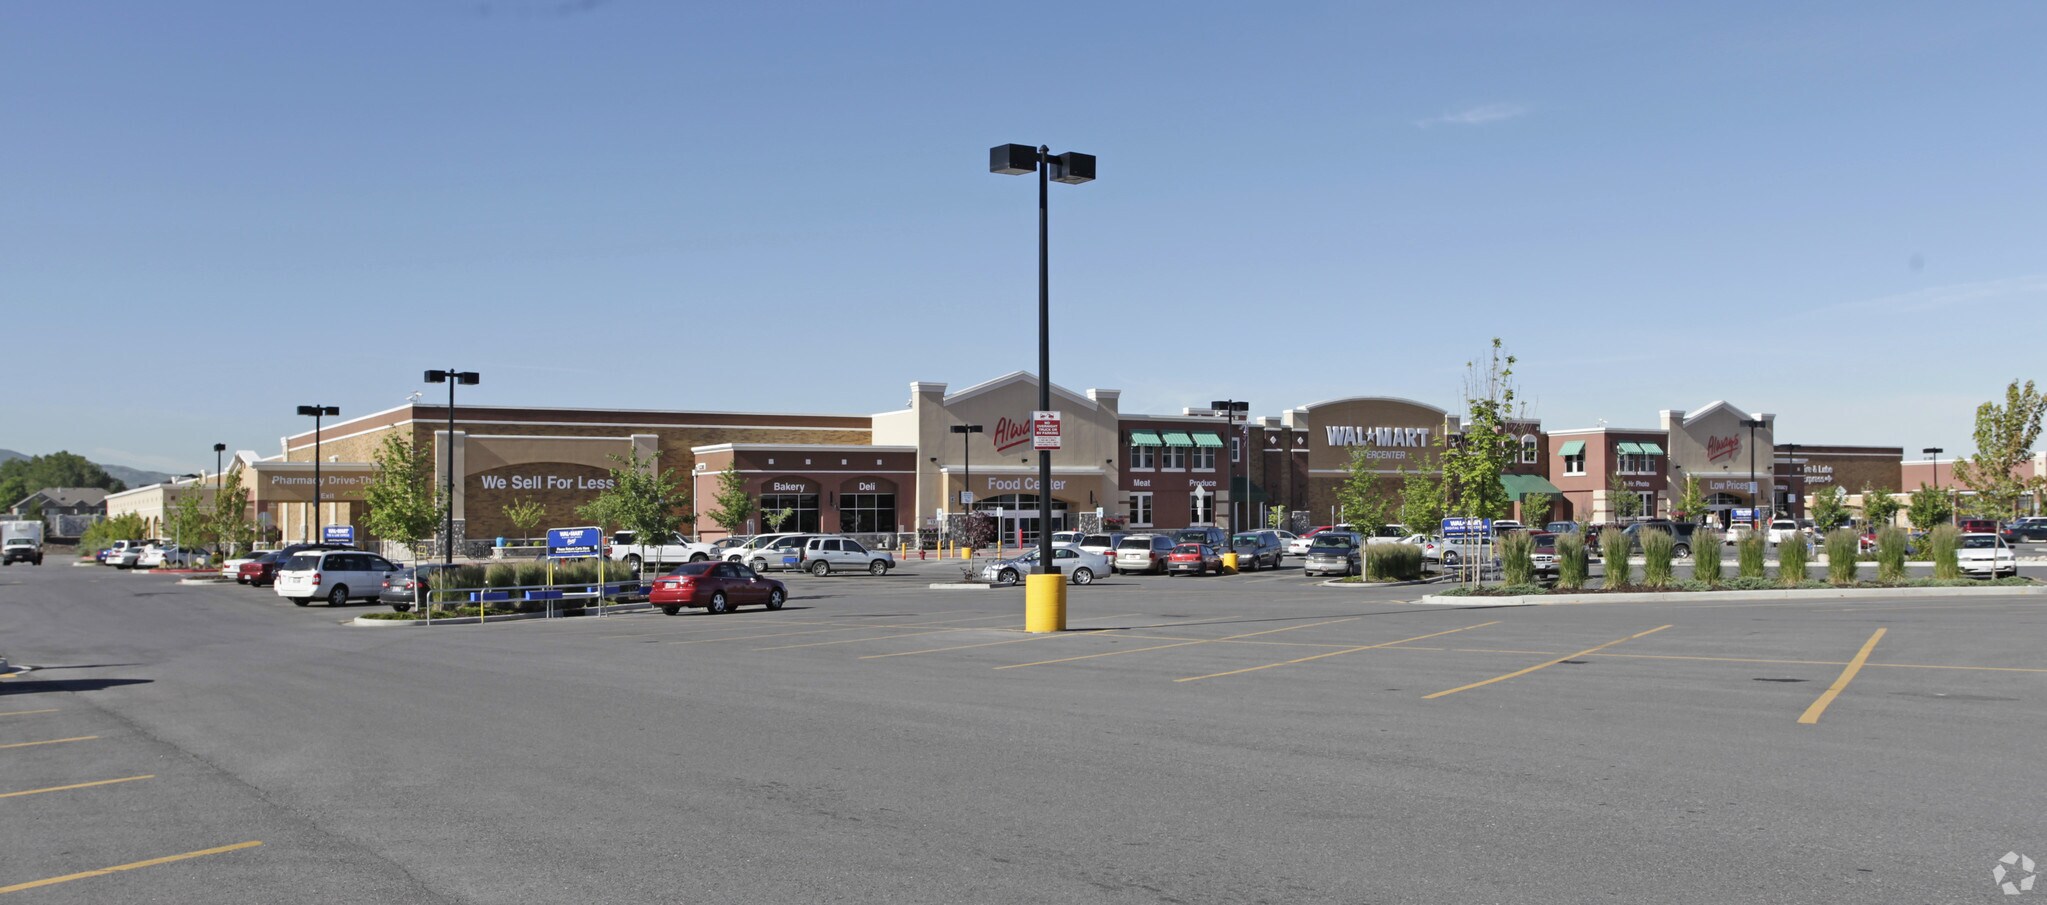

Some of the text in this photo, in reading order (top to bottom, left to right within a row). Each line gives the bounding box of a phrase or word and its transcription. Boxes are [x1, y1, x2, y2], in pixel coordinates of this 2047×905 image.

[993, 417, 1030, 450] Alwa
[1707, 434, 1739, 461] Always
[1818, 465, 1833, 473] Lube
[271, 475, 325, 486] Pharmacy
[482, 475, 615, 489] We Sell For Less
[988, 477, 1066, 490] Food Ceter
[1133, 479, 1151, 487] Meat
[1189, 479, 1217, 487] Produce
[1710, 480, 1748, 489] Low Prices
[773, 482, 805, 493] Bakery
[859, 482, 876, 491] Deli
